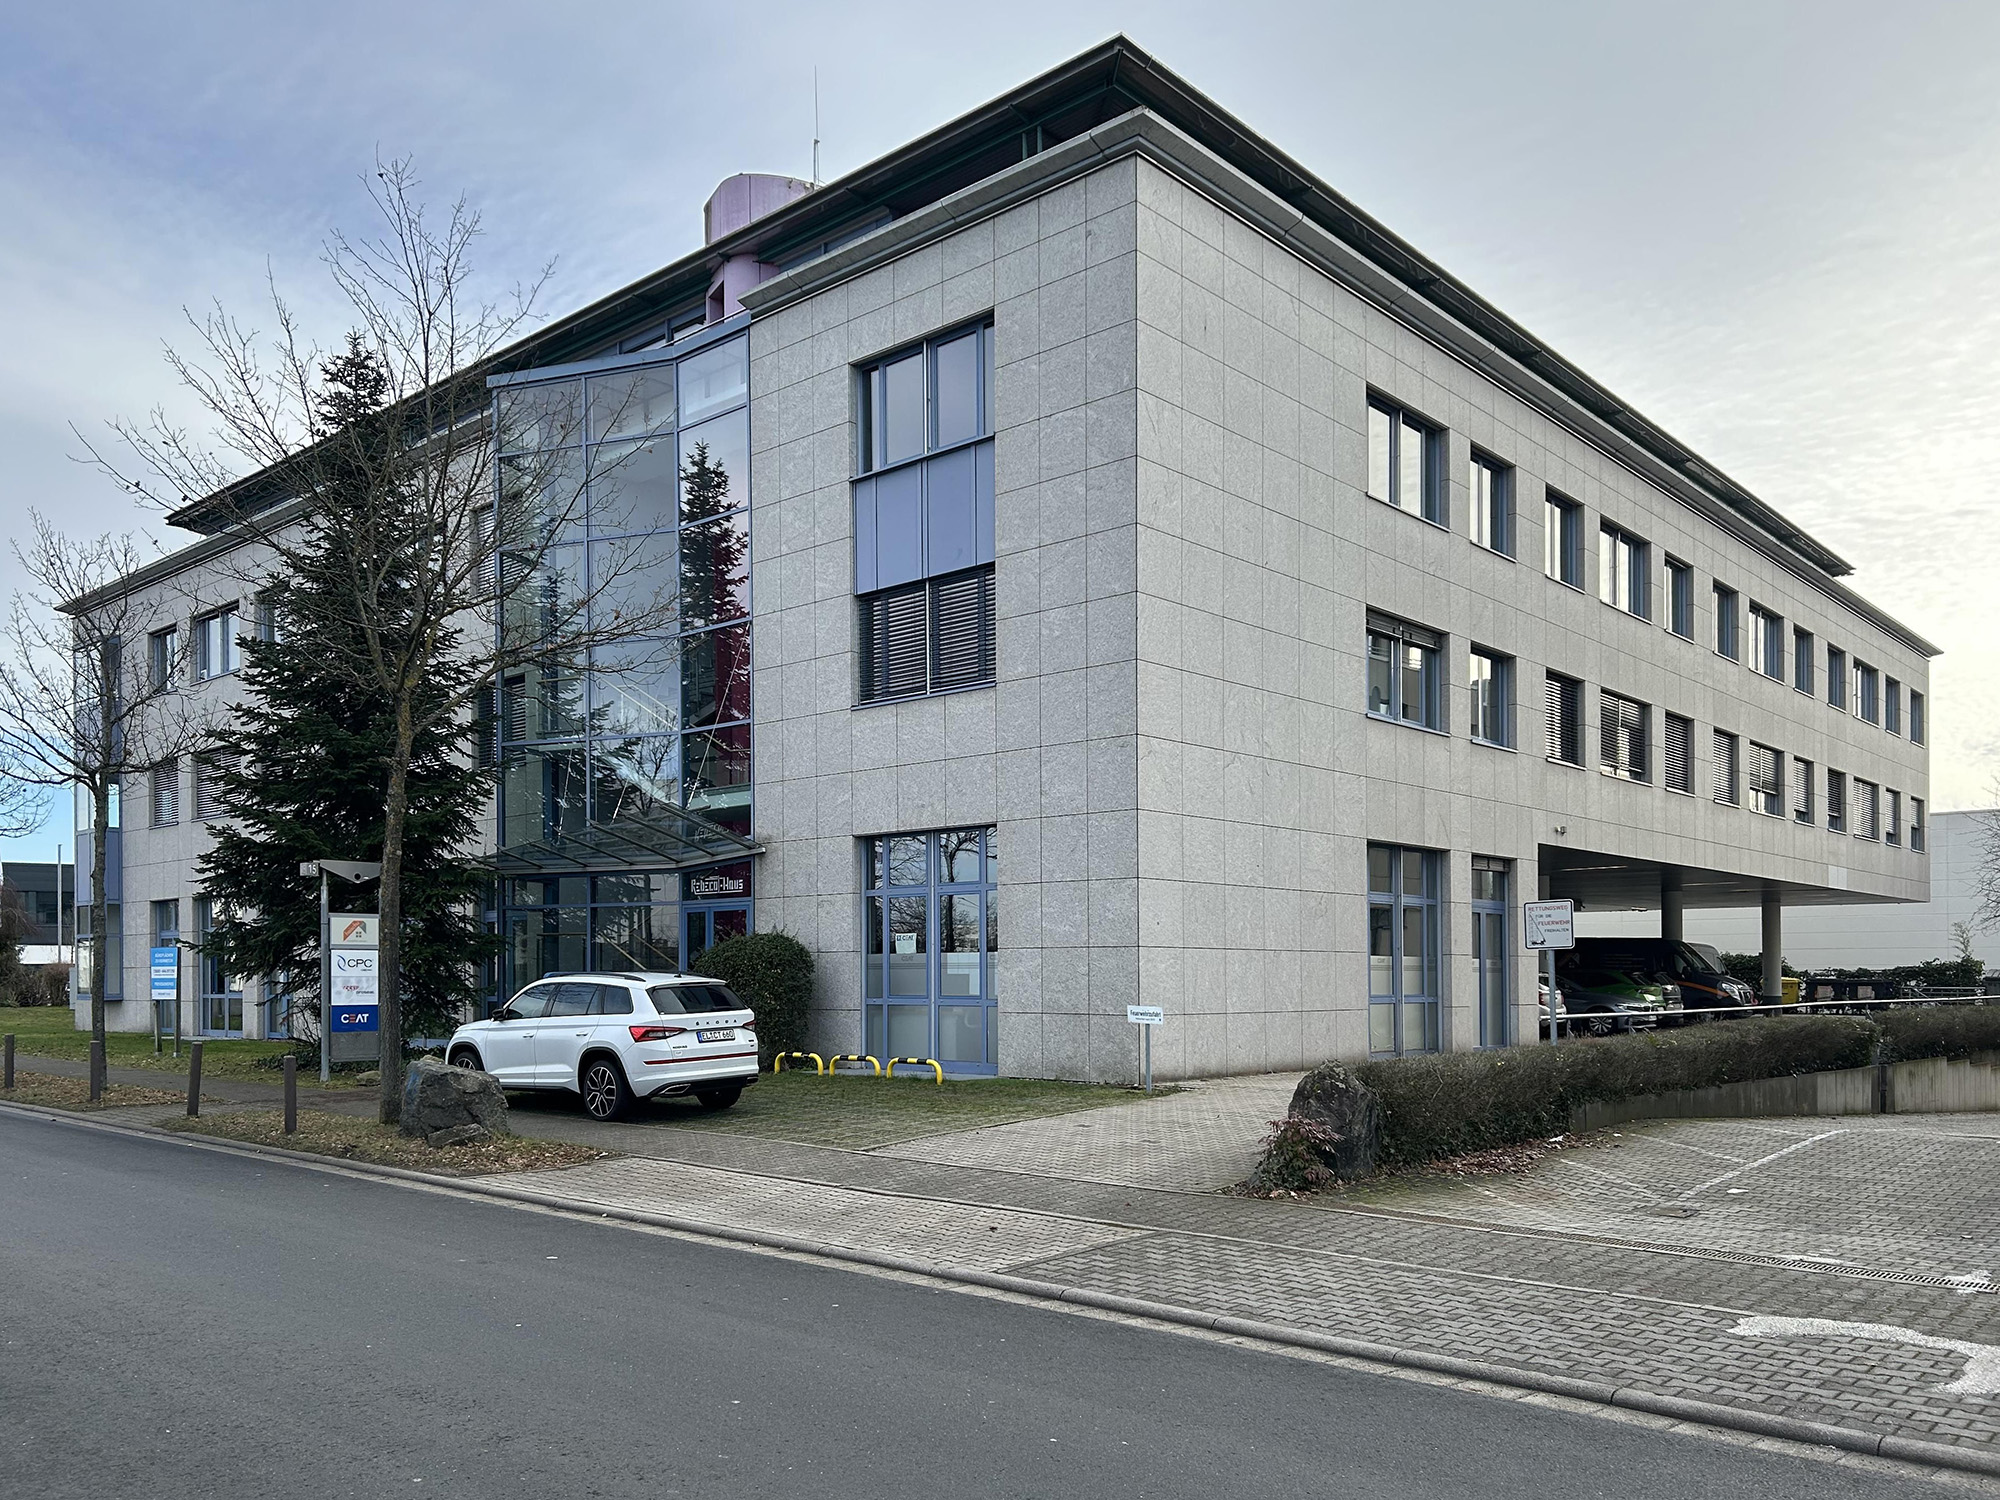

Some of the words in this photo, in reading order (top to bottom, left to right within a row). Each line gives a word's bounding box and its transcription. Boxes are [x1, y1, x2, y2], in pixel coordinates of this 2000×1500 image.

[308, 864, 317, 874] 15
[347, 959, 373, 968] CPC
[341, 1013, 369, 1023] CEAT
